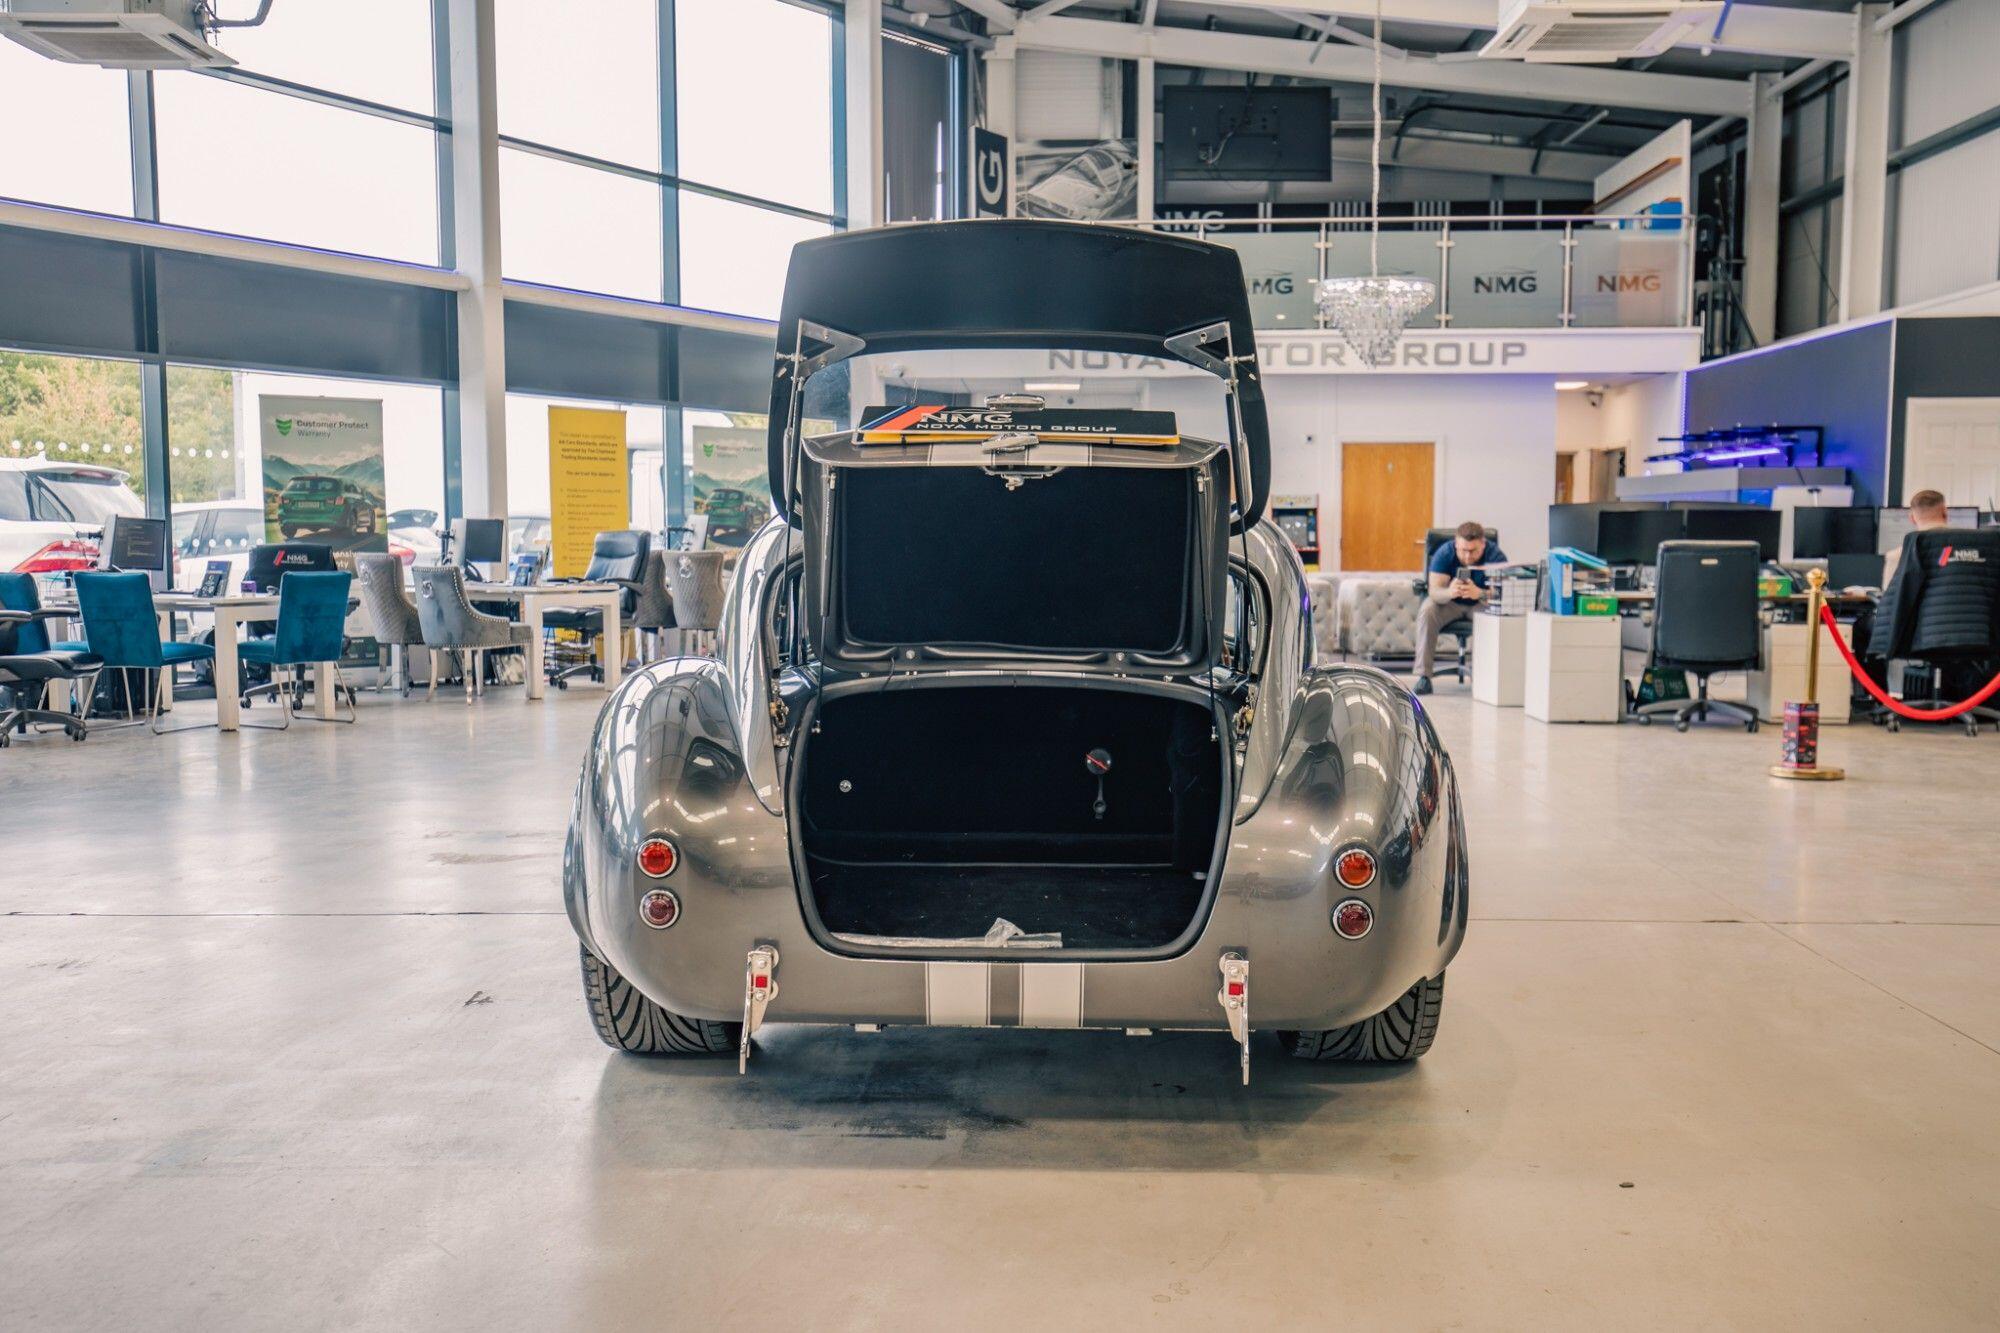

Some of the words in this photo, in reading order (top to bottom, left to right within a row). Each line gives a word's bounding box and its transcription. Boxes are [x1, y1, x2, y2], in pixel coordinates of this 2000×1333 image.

[1252, 278, 1293, 294] MG
[1474, 276, 1537, 293] NMG
[1598, 275, 1661, 292] NMG
[1050, 350, 1165, 369] NOYA
[1257, 342, 1346, 366] TOR
[297, 420, 337, 428] Customer
[339, 421, 368, 429] Protect
[920, 411, 1013, 424] NMG
